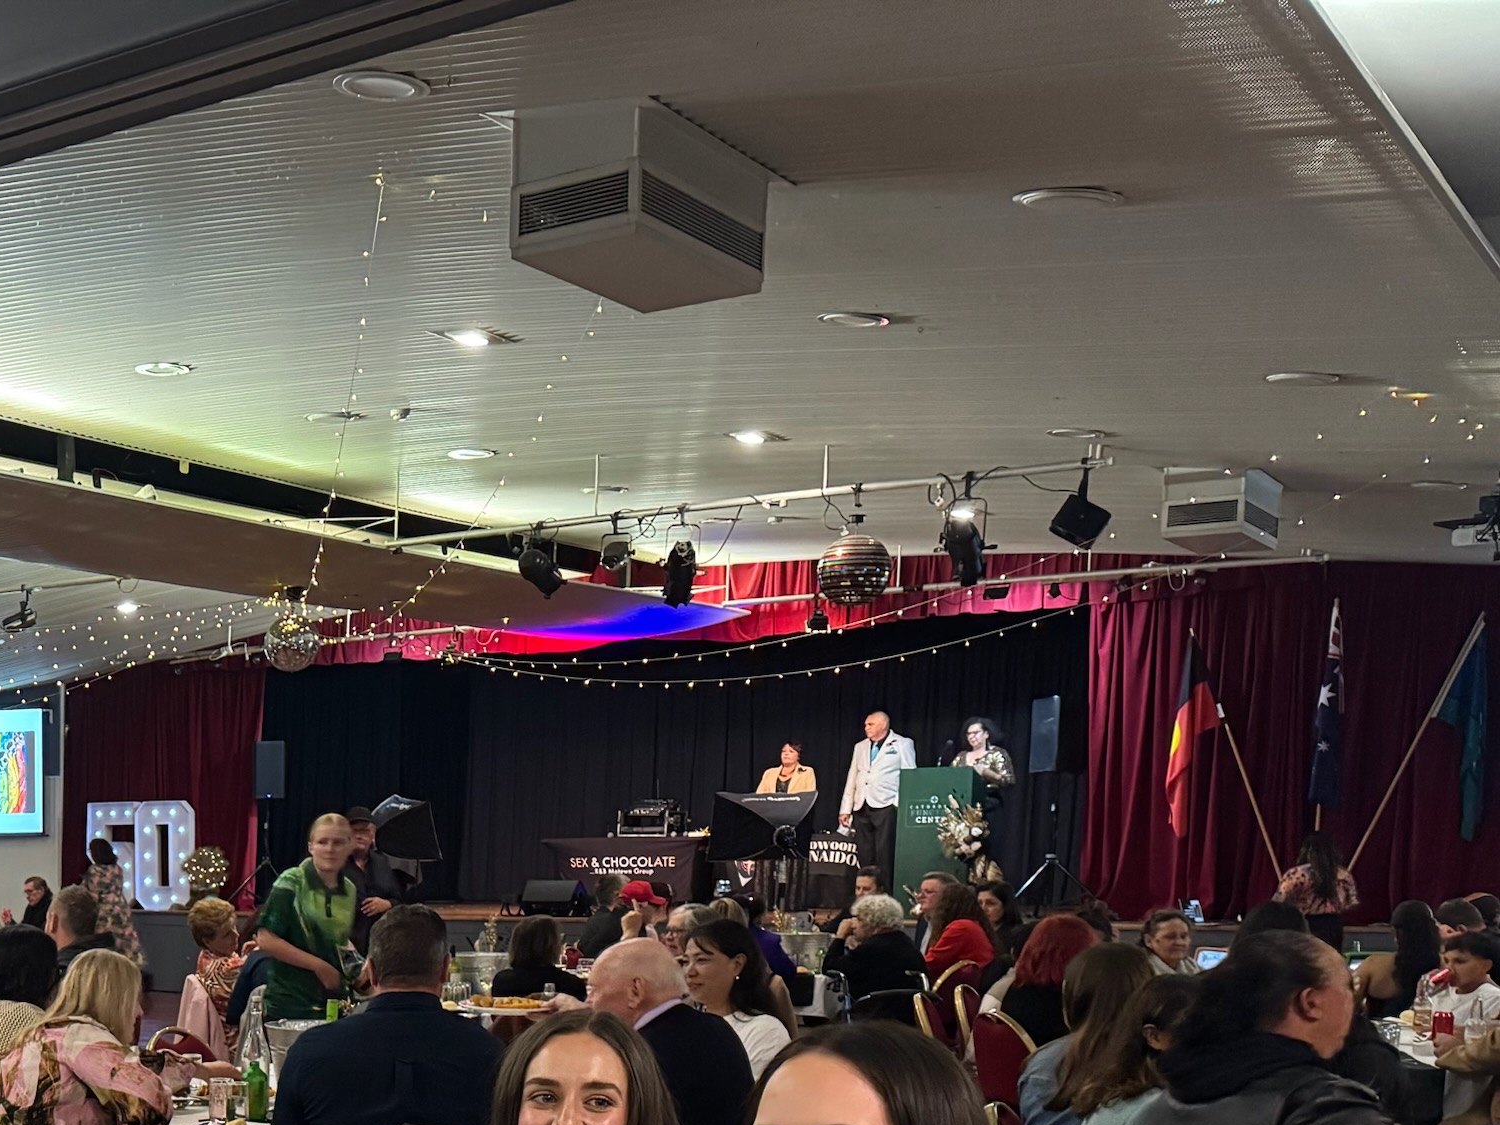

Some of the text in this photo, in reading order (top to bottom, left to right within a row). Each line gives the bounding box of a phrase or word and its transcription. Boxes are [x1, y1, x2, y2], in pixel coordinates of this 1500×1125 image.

[915, 816, 944, 824] CENT
[86, 800, 196, 912] 50
[570, 856, 676, 868] SEX & CHOCOLATE
[808, 850, 861, 869] NAIDO
[633, 868, 655, 876] Group
